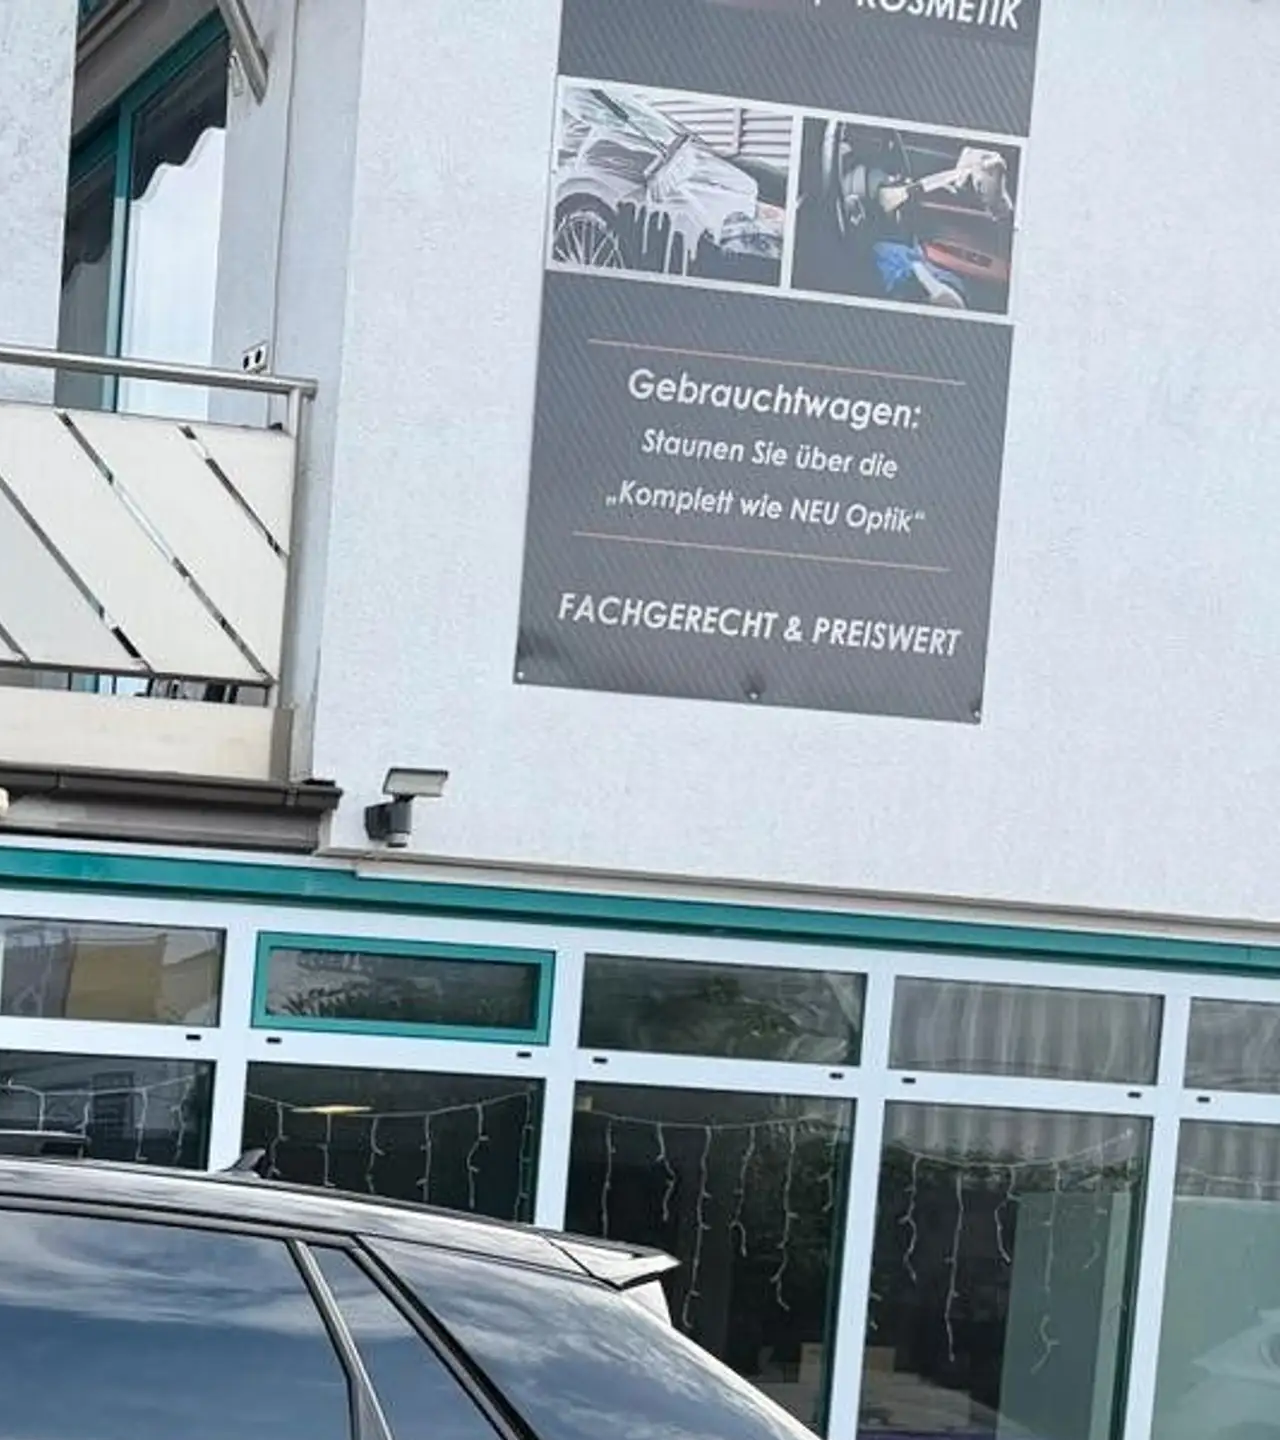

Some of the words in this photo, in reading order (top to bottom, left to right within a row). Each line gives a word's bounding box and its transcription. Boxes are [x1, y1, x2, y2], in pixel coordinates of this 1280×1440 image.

[628, 368, 922, 431] Gebrauchtwagen:
[641, 428, 744, 463] Staunen
[751, 440, 789, 467] Sie
[796, 444, 853, 474] über
[859, 453, 898, 479] die
[740, 494, 783, 520] wie
[790, 499, 839, 526] NEU
[557, 592, 778, 639] FACHGERECHT
[783, 617, 803, 642] &
[812, 616, 962, 657] PREISWERT
